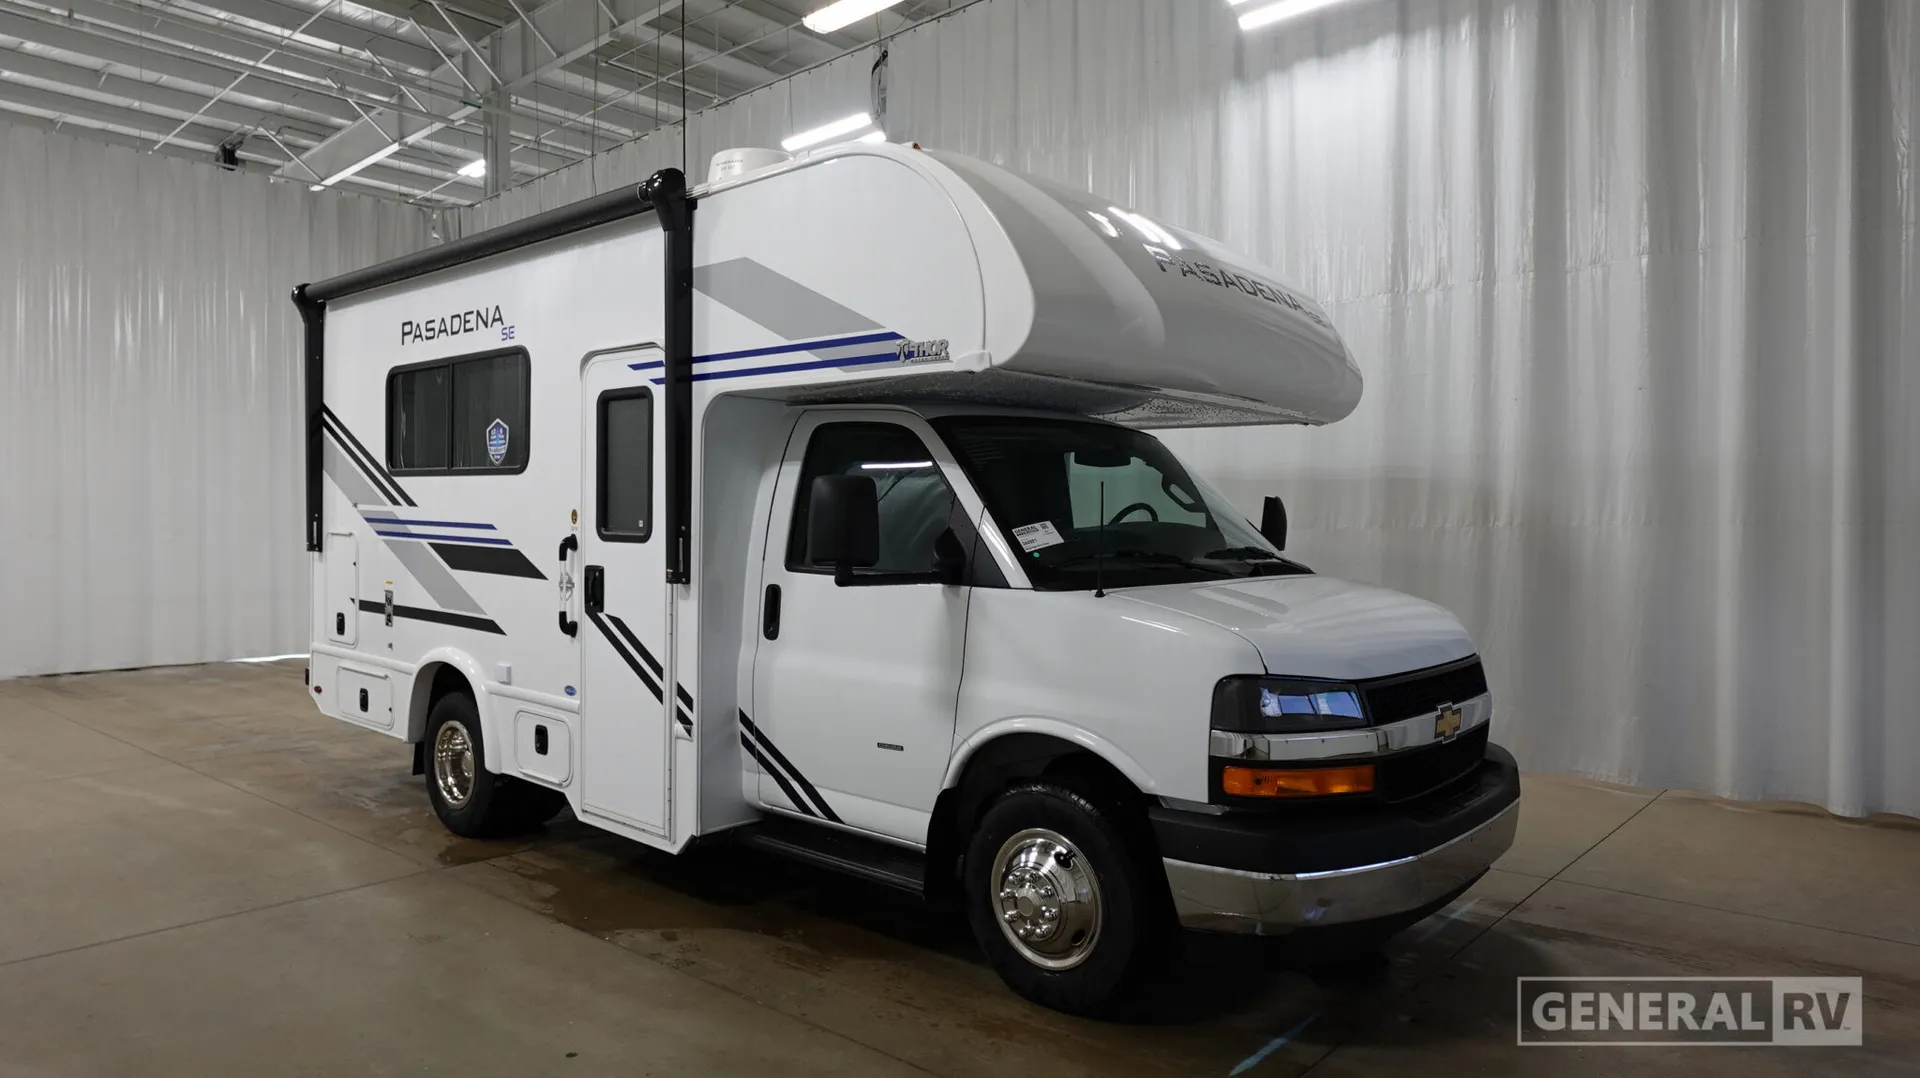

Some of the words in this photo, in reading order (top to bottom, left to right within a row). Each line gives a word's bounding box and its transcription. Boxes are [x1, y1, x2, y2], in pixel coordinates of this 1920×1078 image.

[1143, 243, 1309, 315] PASADENA
[401, 305, 504, 346] PASADENA
[501, 325, 515, 341] SE
[912, 339, 950, 359] THOR
